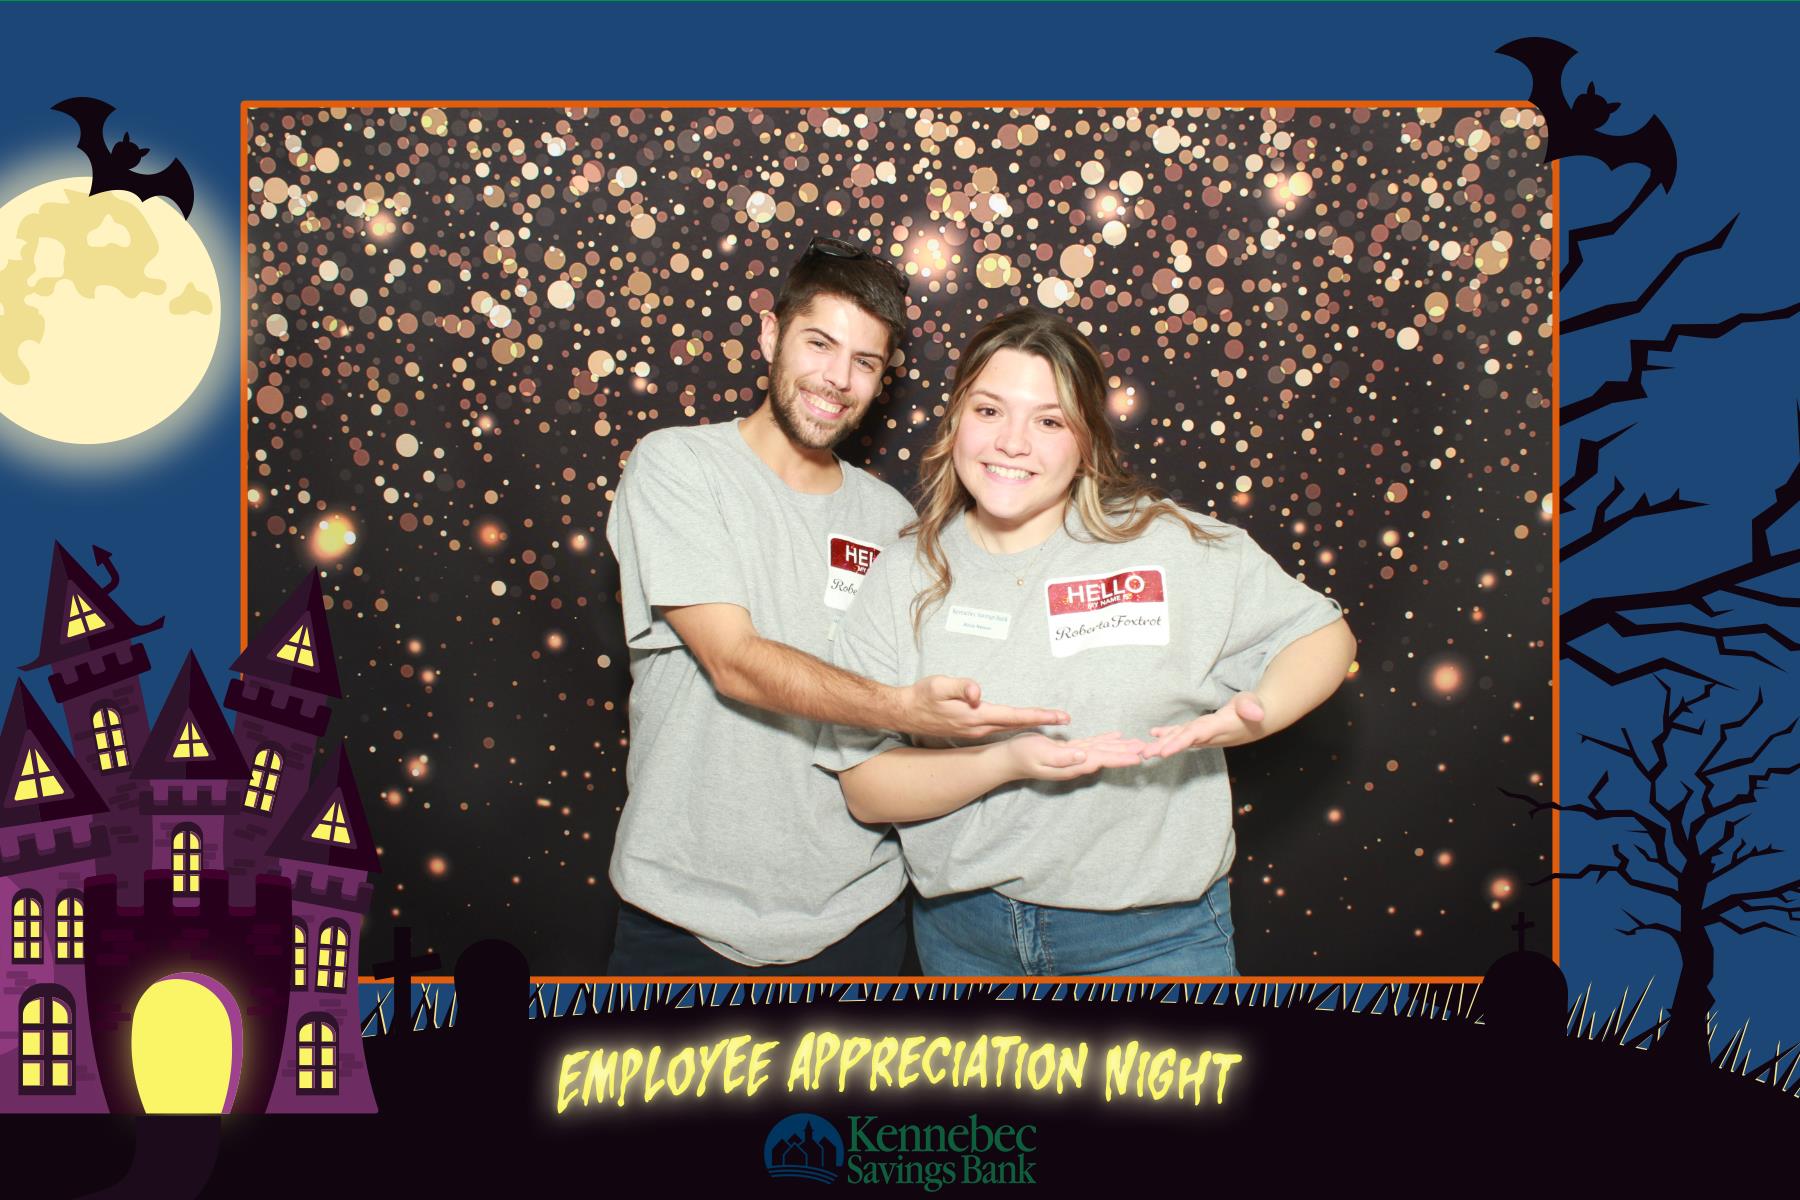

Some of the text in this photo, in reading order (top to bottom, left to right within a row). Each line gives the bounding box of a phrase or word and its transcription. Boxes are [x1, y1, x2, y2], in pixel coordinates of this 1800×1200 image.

[1067, 575, 1146, 604] HELLO
[1087, 601, 1099, 610] MY
[1100, 595, 1121, 607] NAME
[1055, 614, 1162, 641] Roberta Foxtrot
